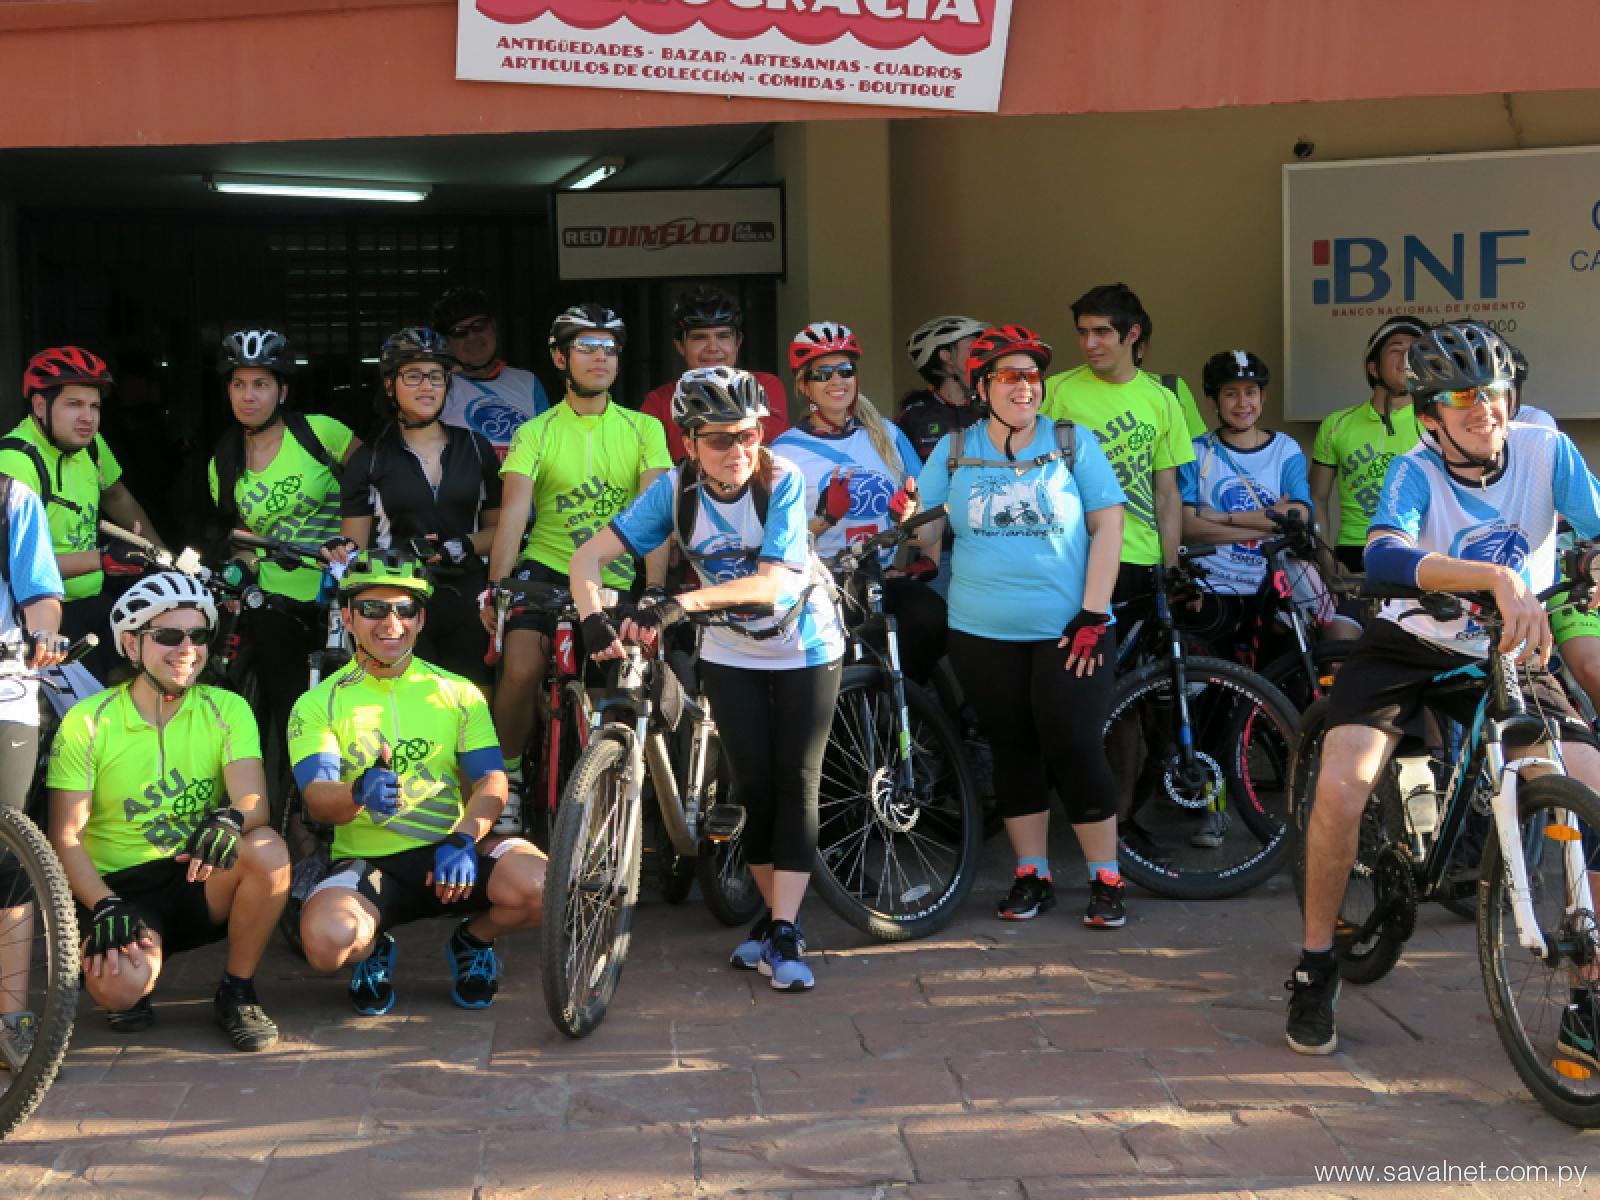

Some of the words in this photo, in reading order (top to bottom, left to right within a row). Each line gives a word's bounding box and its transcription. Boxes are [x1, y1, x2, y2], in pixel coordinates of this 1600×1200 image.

[496, 36, 645, 58] ANTIGÜEDADES
[661, 47, 727, 63] BAZAR
[740, 53, 861, 73] ARTESANIAS
[873, 61, 963, 80] CUADROS
[501, 55, 609, 74] ARTICULOS
[613, 63, 638, 77] DE
[642, 64, 745, 83] COLECCIÓN
[757, 73, 846, 91] COMIDAS
[858, 79, 957, 99] BOUTIQUE
[1333, 229, 1530, 304] BNF
[1331, 306, 1375, 318] BANCO
[1377, 304, 1441, 316] NACIONAL
[1445, 303, 1462, 313] DE
[1465, 301, 1527, 313] FOMENTO
[123, 768, 187, 823] ASU
